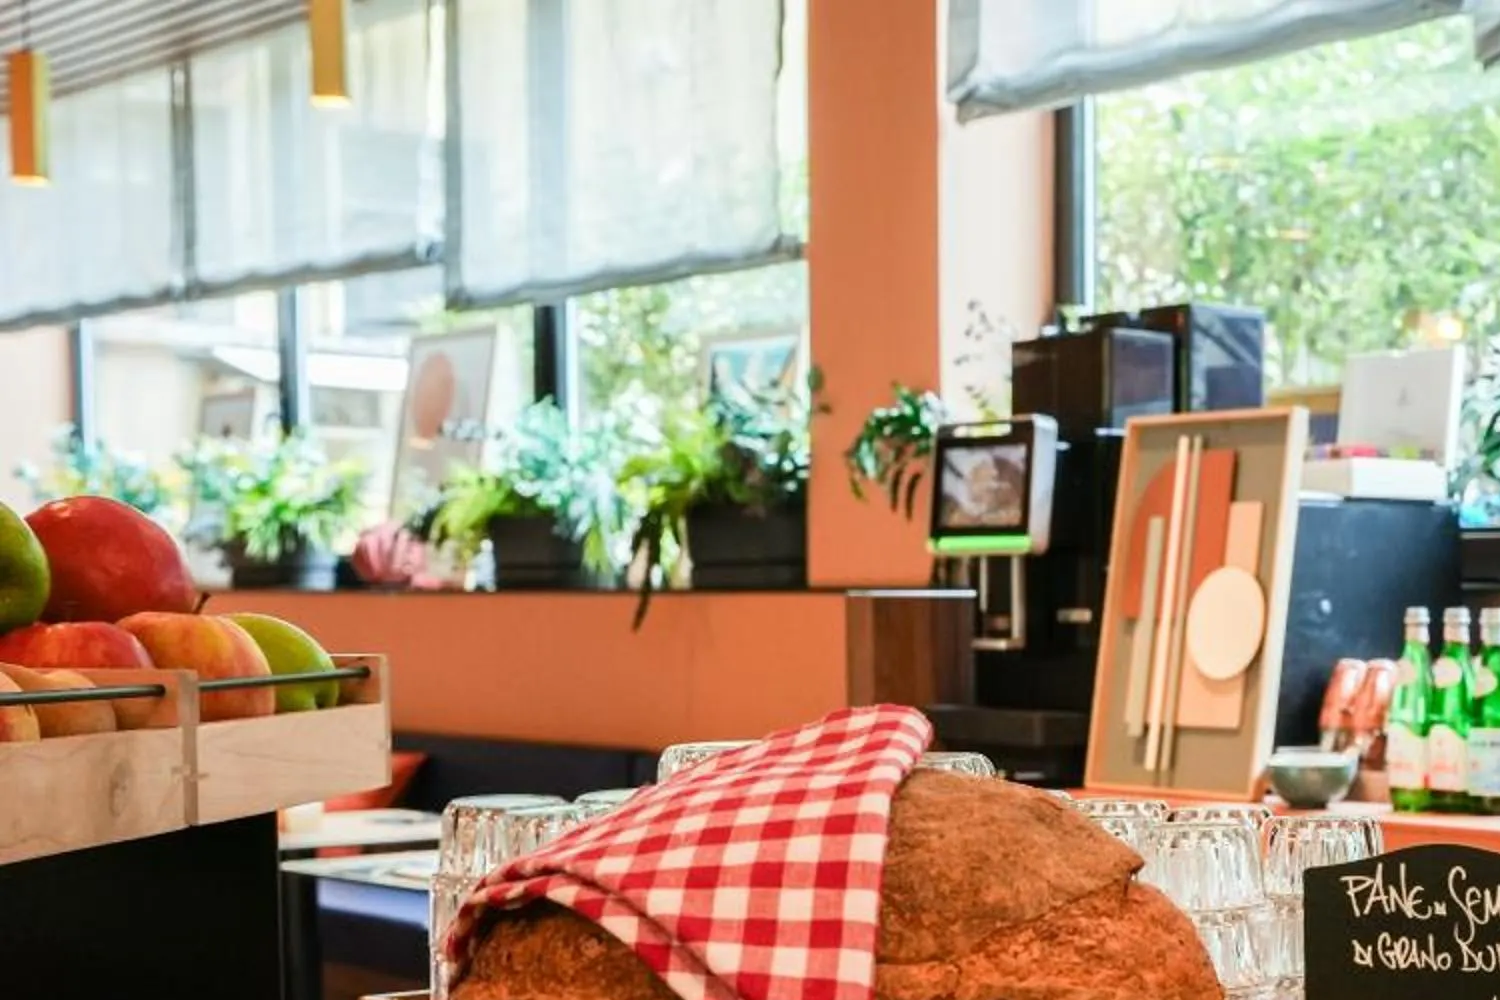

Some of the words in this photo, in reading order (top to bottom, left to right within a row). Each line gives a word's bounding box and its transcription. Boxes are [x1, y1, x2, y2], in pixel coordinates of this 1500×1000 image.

[1340, 862, 1432, 919] PANE
[1352, 939, 1374, 968] DI
[1377, 931, 1452, 971] GRANO
